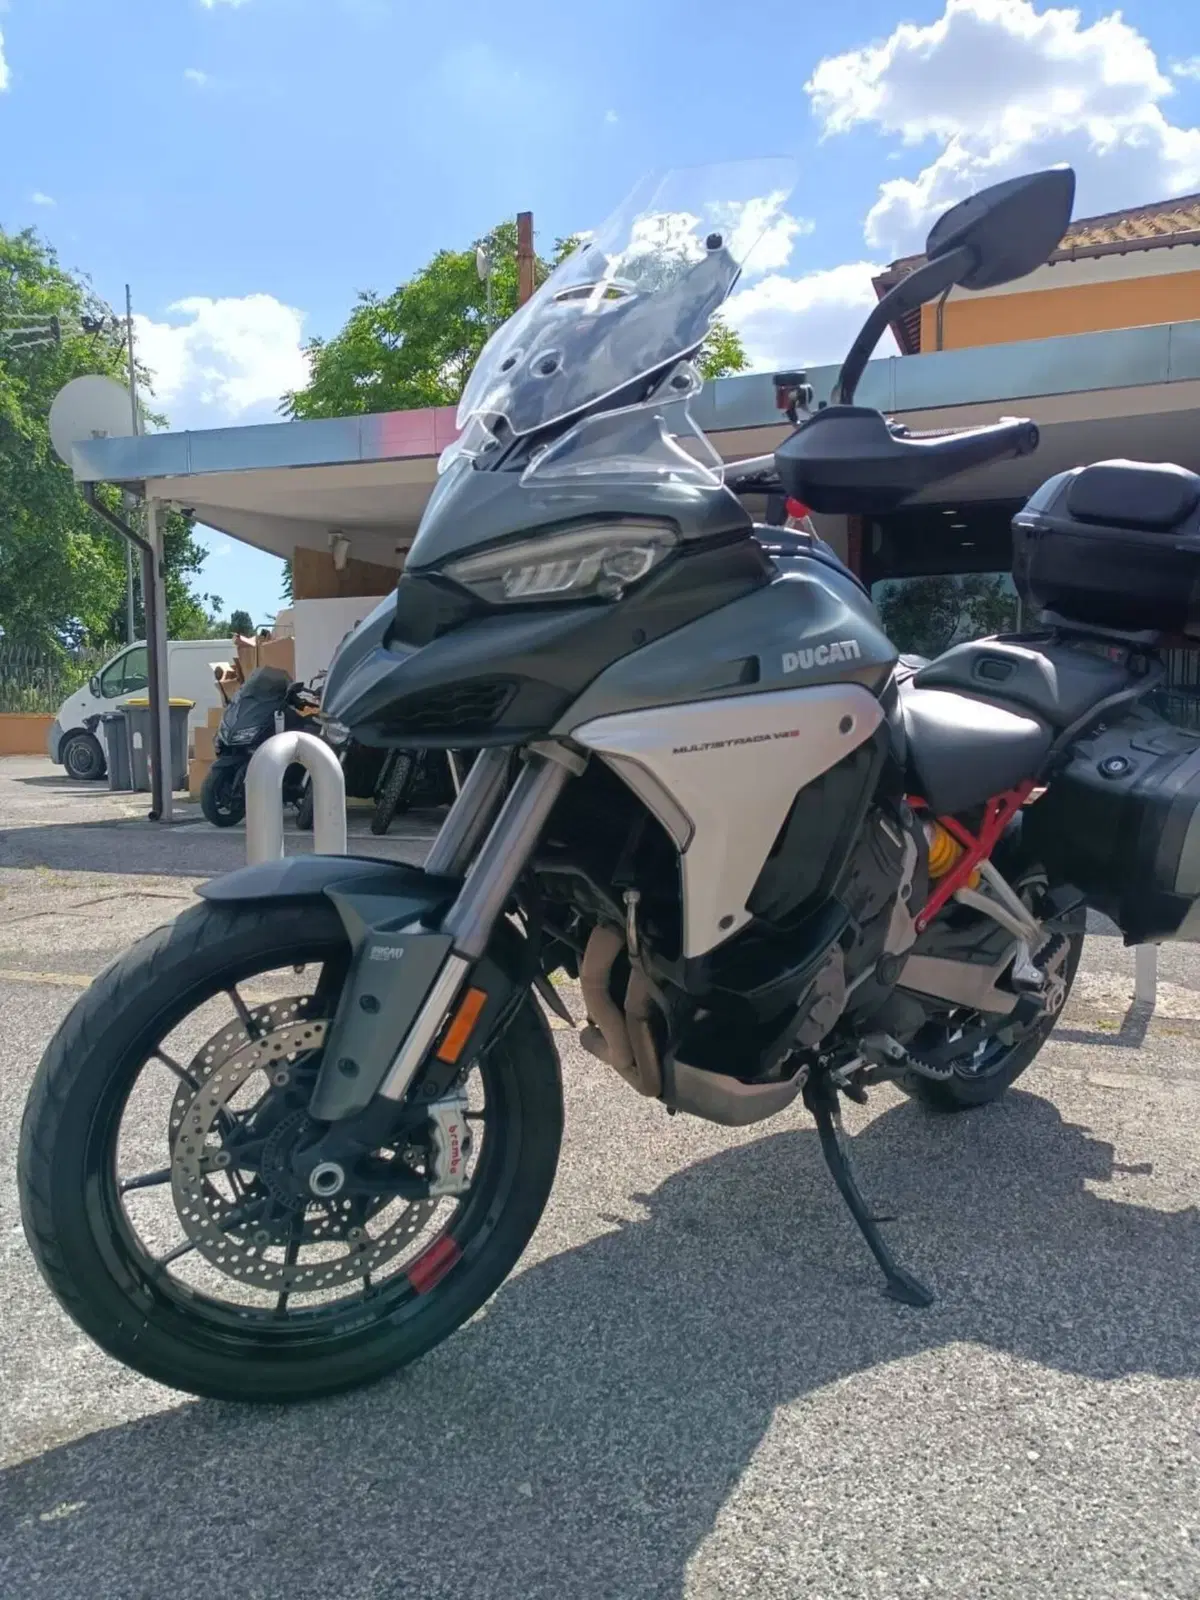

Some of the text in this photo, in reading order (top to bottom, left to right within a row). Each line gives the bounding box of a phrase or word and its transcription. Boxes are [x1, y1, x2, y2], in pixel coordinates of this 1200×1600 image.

[781, 640, 862, 674] DUCATI
[672, 734, 772, 755] MULTISTRADA
[448, 1124, 462, 1175] brembo
